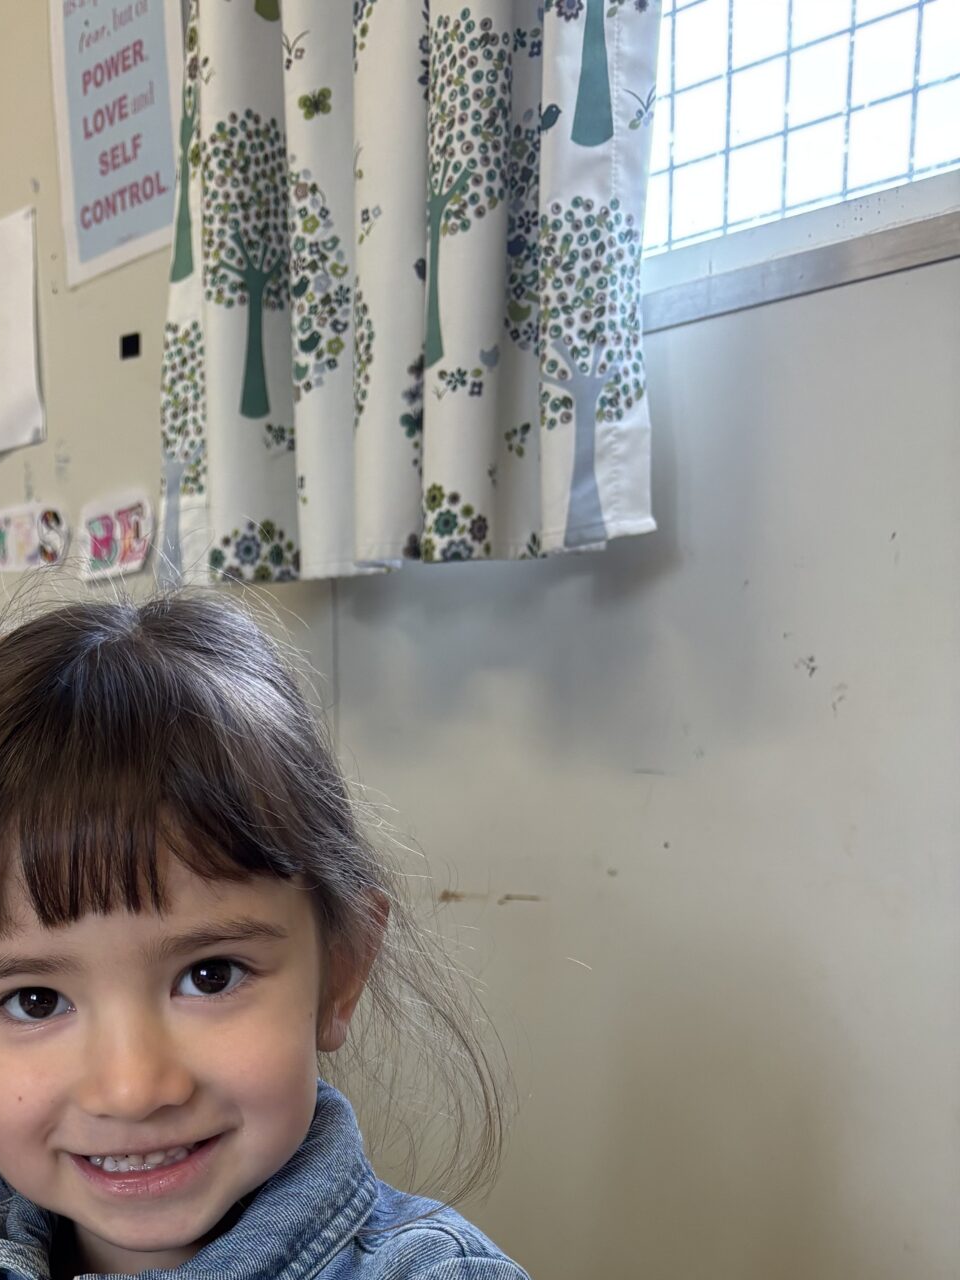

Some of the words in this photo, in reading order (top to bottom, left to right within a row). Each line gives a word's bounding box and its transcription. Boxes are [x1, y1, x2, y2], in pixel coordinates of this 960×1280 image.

[83, 94, 130, 140] LOVE
[131, 80, 155, 116] and
[98, 133, 143, 176] SELF
[88, 502, 147, 571] BE
